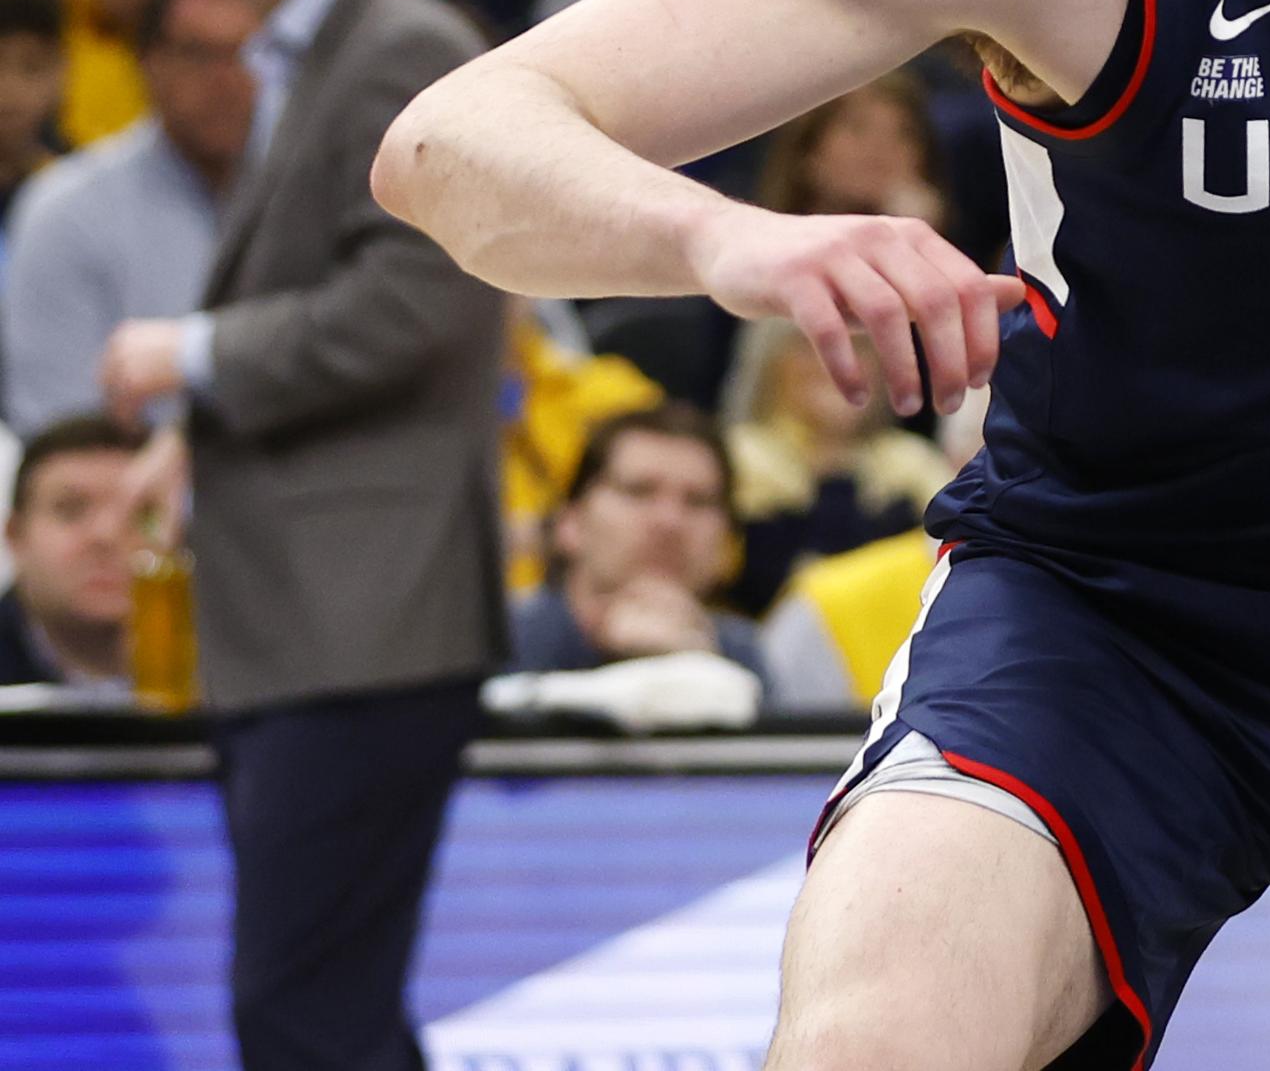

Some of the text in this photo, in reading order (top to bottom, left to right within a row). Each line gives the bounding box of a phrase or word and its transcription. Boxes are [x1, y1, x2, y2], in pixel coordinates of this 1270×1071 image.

[1198, 57, 1261, 78] BE THE
[1190, 77, 1264, 99] CHANGE
